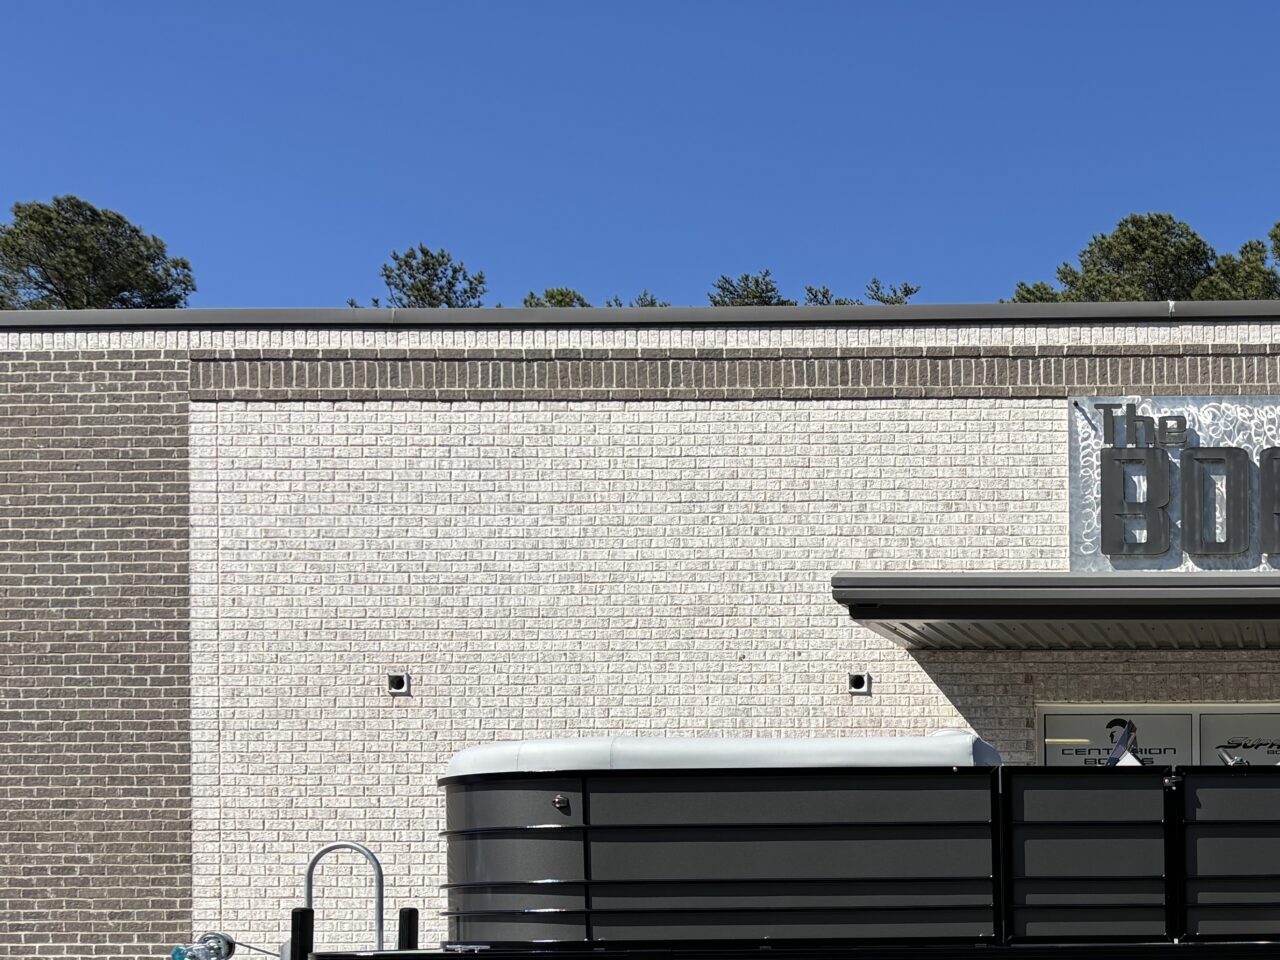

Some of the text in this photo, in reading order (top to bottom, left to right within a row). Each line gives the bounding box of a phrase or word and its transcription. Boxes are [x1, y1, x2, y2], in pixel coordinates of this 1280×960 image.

[1095, 403, 1188, 445] The
[1061, 747, 1177, 756] CENTION
[1084, 757, 1155, 766] BOS
